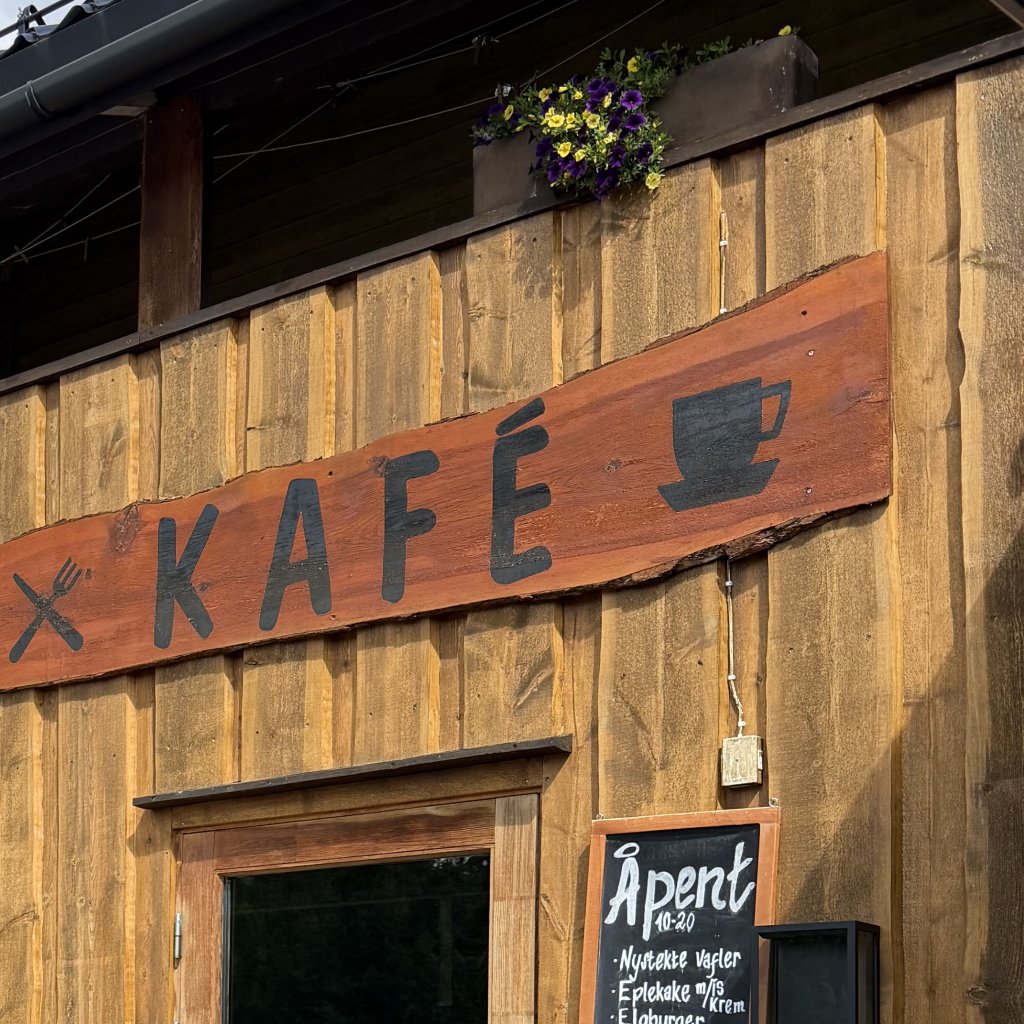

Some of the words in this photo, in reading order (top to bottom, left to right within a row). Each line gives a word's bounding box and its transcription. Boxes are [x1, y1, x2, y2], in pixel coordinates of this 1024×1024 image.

[153, 398, 553, 649] KAFÉ
[604, 842, 756, 941] Åpent
[655, 911, 696, 932] 10-20
[619, 945, 688, 982] Nystekte
[618, 979, 691, 1008] Eplekake
